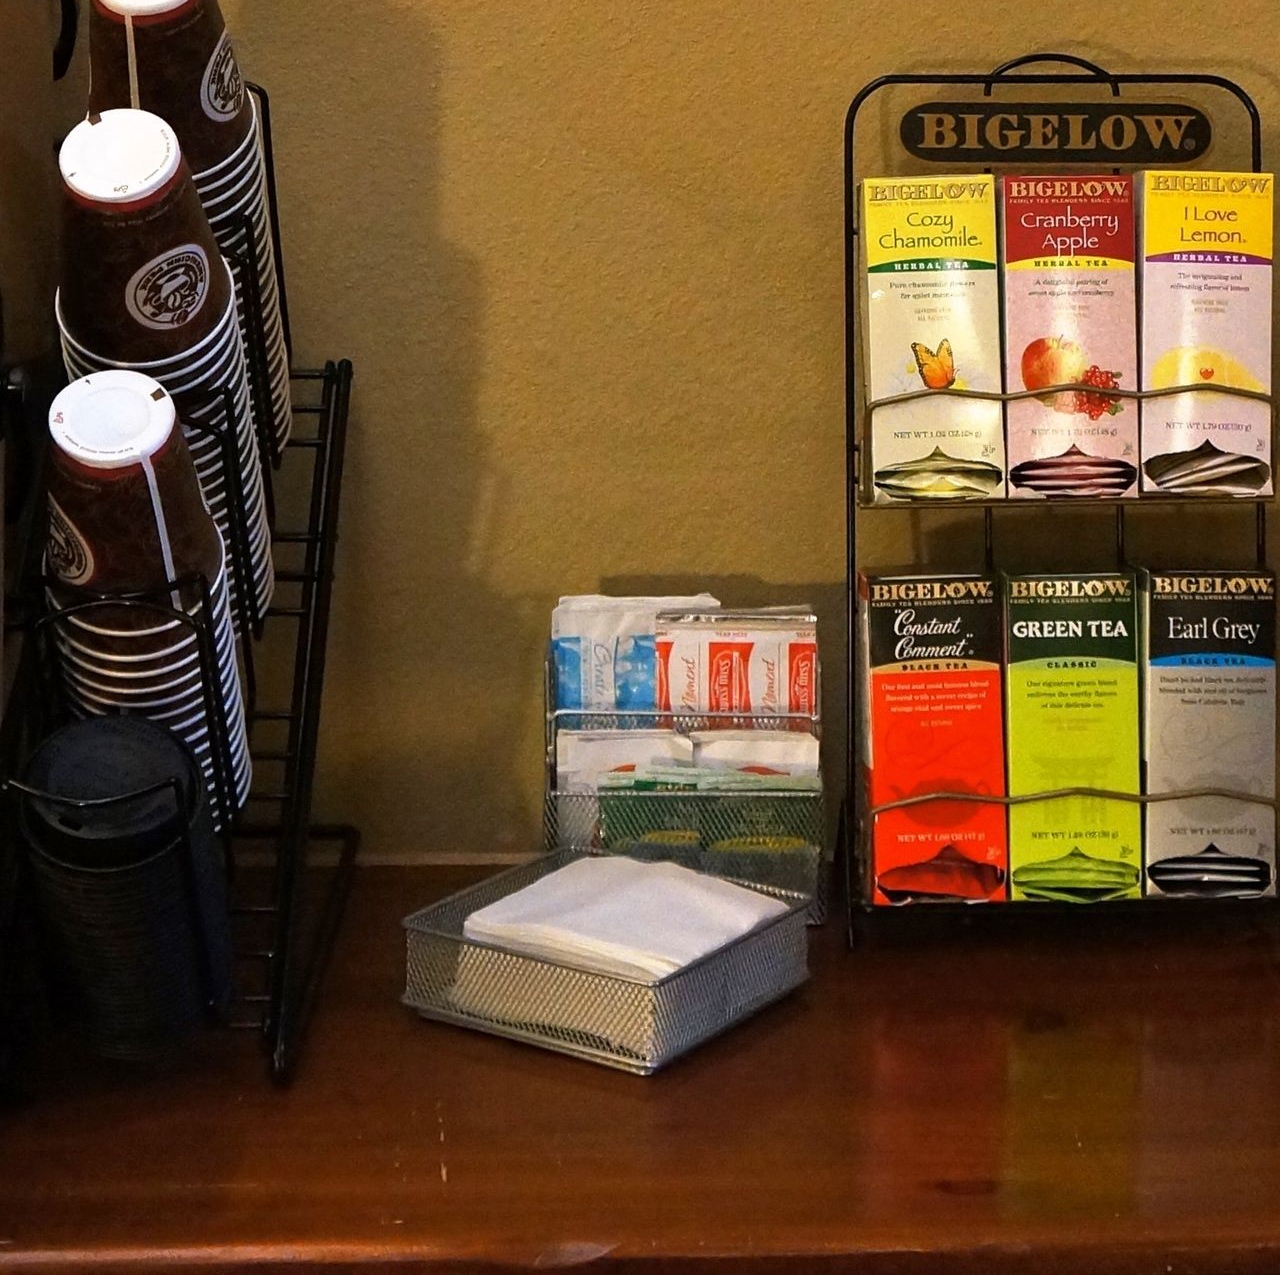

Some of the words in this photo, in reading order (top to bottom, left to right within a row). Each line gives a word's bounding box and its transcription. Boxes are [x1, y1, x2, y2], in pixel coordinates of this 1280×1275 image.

[917, 113, 1190, 150] BIGELOW
[868, 183, 989, 201] BIGELOW
[1010, 181, 1128, 197] BIGELOW
[1152, 175, 1271, 194] BIGELOW
[1021, 205, 1119, 235] Cranberry
[1194, 206, 1238, 222] Love
[906, 212, 954, 234] Cozy
[879, 226, 978, 249] Chamomile
[1042, 226, 1100, 257] Apple
[1180, 227, 1242, 243] Lemon
[894, 262, 941, 270] HERBAL
[945, 261, 969, 269] TEA
[1174, 254, 1220, 262] HERBAL
[1224, 255, 1248, 263] TEA
[871, 581, 992, 600] BIGELOW
[1010, 580, 1130, 597] BIGELOW
[1153, 577, 1273, 594] BIGELOW
[1012, 620, 1082, 638] GREEN
[1087, 620, 1129, 638] TEA
[1168, 616, 1208, 639] Earl
[1212, 616, 1261, 645] Grey
[902, 663, 939, 671] BLACK
[946, 662, 968, 670] TEA
[1047, 660, 1097, 669] CLASSIC
[1224, 657, 1246, 665] TEA
